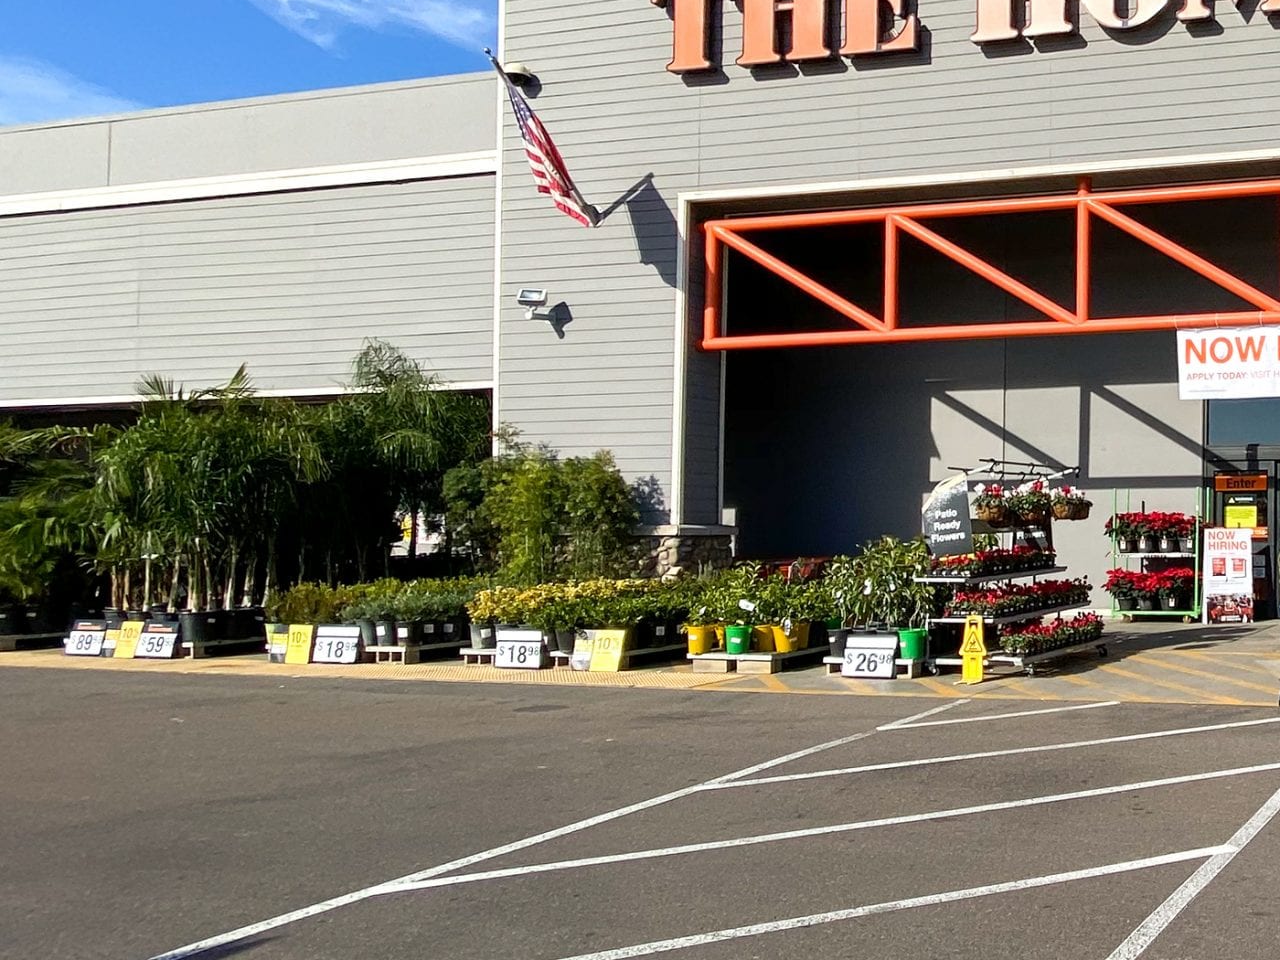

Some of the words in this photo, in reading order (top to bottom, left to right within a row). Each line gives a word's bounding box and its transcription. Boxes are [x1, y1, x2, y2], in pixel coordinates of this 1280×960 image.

[1185, 335, 1266, 364] NOW
[1186, 372, 1214, 381] APPLY
[1226, 478, 1257, 489] Enter
[935, 509, 958, 519] Patio
[933, 520, 961, 531] Ready
[931, 532, 966, 543] Flowers
[1208, 531, 1235, 540] NOW
[1208, 541, 1248, 550] HIRING
[326, 640, 344, 658] 18
[508, 644, 527, 664] 18
[855, 652, 878, 672] 26
